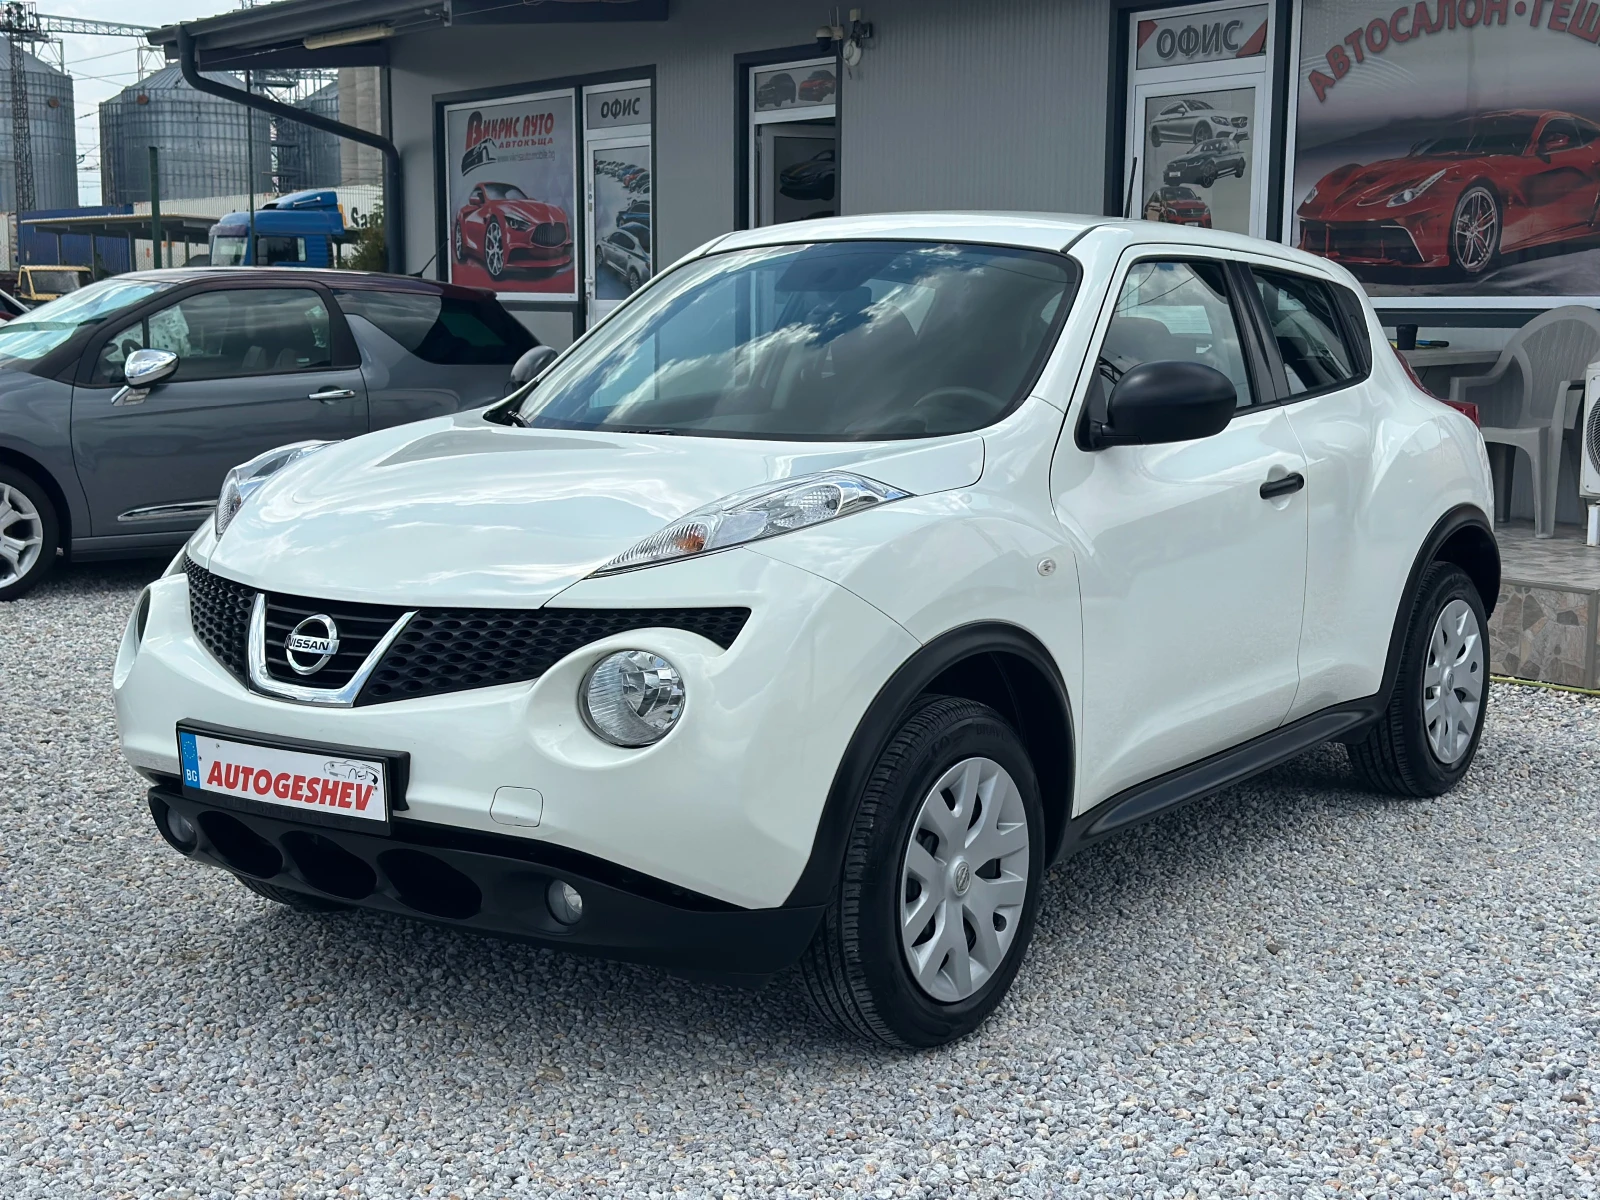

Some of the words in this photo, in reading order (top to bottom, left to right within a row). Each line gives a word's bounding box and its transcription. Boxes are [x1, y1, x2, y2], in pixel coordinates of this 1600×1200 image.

[1156, 20, 1241, 59] ОФИС
[1308, 0, 1507, 103] АВТОСАЛОН
[1530, 0, 1600, 45] ГЕШ
[601, 97, 640, 119] ОФИС
[499, 137, 554, 149] АВТОКЪЩА
[288, 637, 330, 650] NISSAN
[186, 769, 198, 781] BG
[207, 760, 374, 811] AUTOGESHEV
